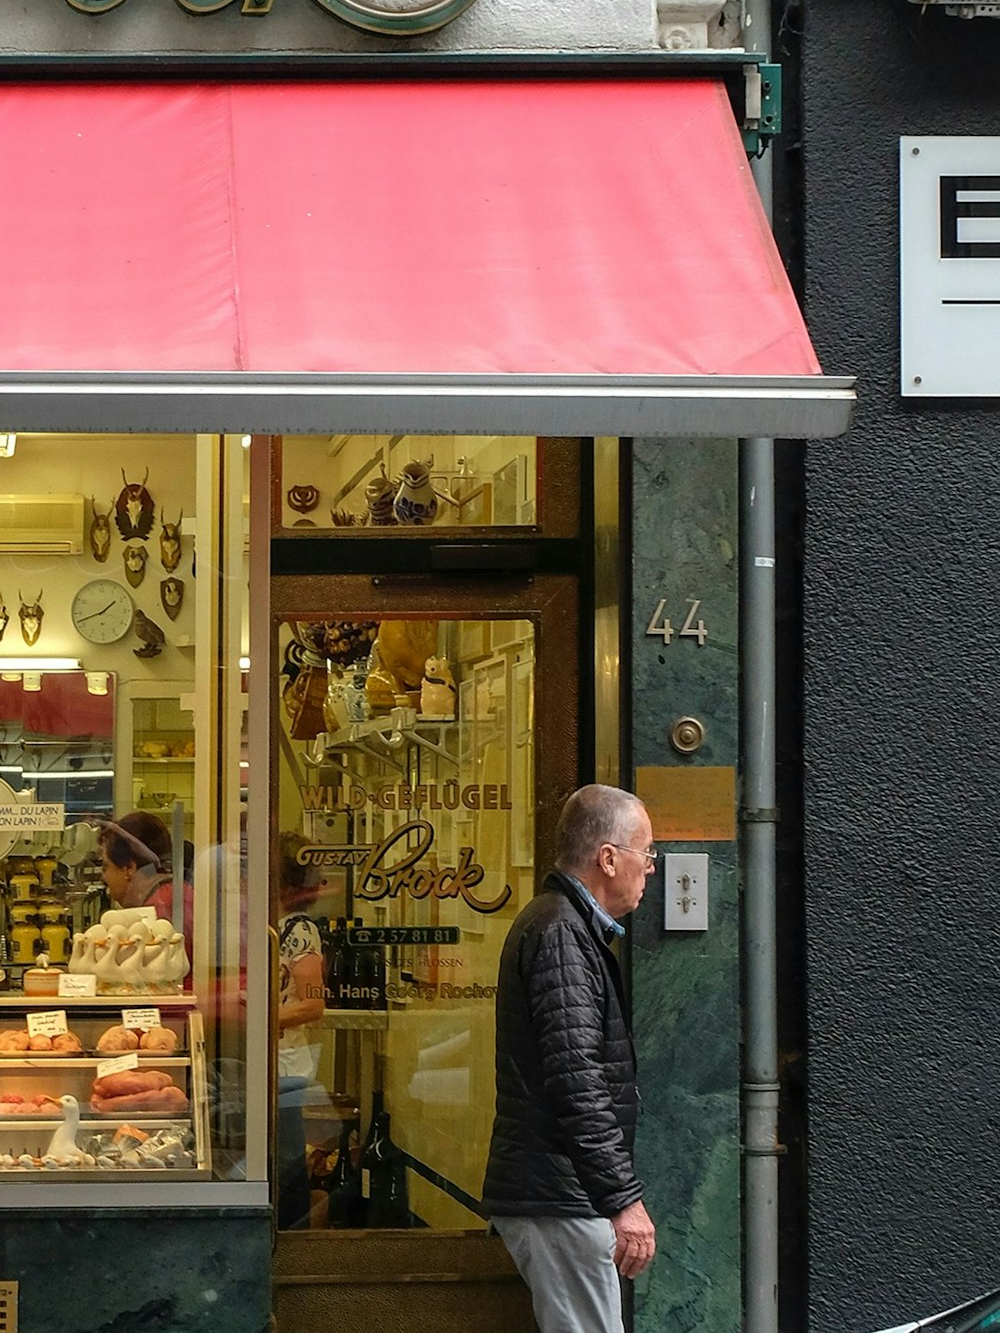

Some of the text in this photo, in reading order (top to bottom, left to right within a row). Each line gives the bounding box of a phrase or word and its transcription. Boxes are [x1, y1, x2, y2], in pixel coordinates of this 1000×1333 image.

[646, 598, 708, 645] 44
[20, 807, 34, 815] DU
[296, 819, 512, 913] GUSTAV Brock
[376, 930, 451, 942] 2 57 81 81
[306, 982, 497, 1002] Inh. Hans Georg Rocho
